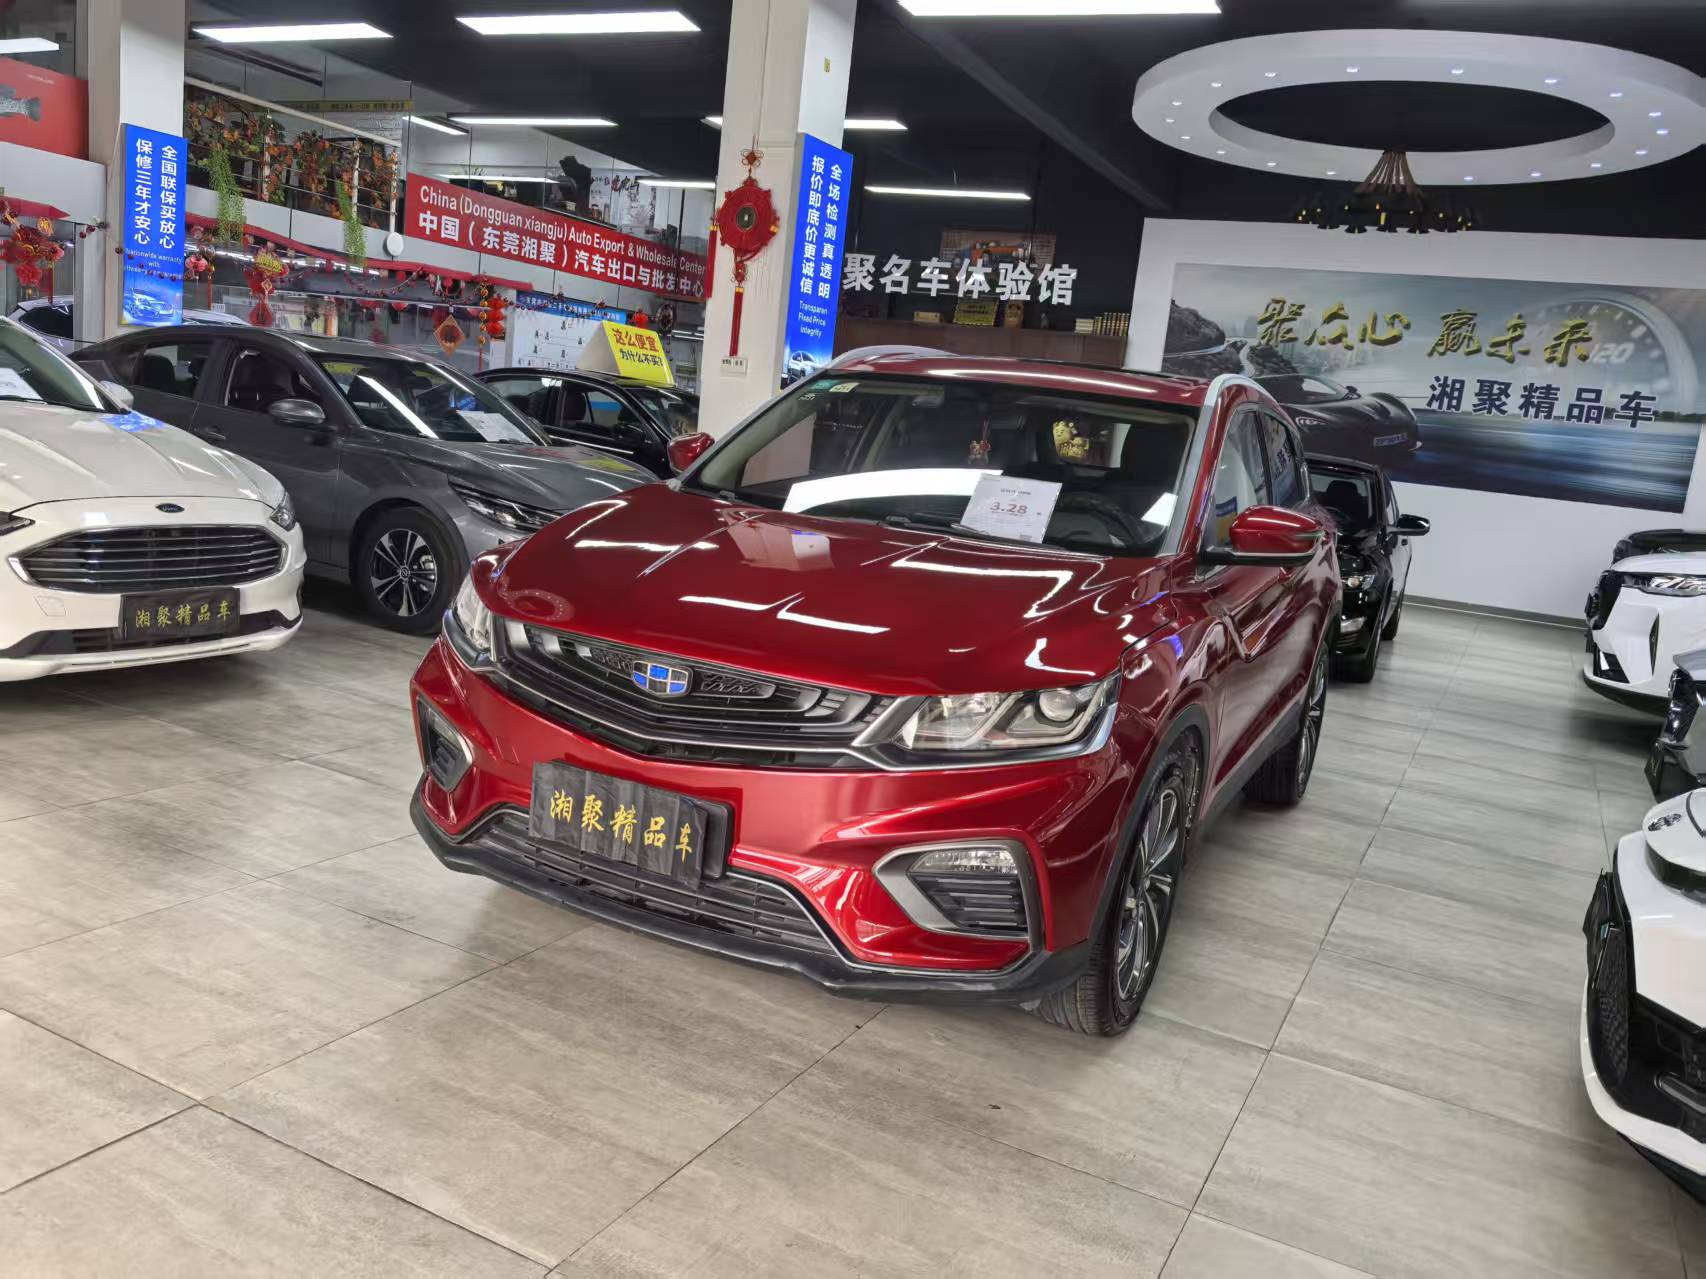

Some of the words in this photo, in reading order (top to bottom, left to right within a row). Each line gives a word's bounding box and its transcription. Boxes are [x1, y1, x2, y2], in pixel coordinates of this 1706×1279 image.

[134, 138, 152, 245] 保修三年才安心
[159, 145, 177, 249] 全国联保买放心
[420, 186, 457, 211] China
[460, 193, 523, 228] (Dongguan
[525, 216, 567, 242] xiangju)
[569, 230, 592, 247] Auto
[593, 235, 625, 256] Export
[628, 244, 635, 257] &
[636, 245, 677, 269] Wholesale
[679, 256, 705, 275] Center
[800, 155, 824, 295] 报价即底价更诚信
[818, 164, 842, 299] 全场检测真透明
[842, 252, 1077, 305] 聚名车体验馆
[612, 328, 659, 353] 这么便宜
[798, 312, 813, 323] Fixed
[813, 315, 827, 327] Price
[1426, 375, 1658, 429] 湘聚精品车
[990, 501, 1028, 515] 3.28
[135, 599, 231, 628] 湘聚精品车
[550, 789, 693, 864] 湘聚精品车
